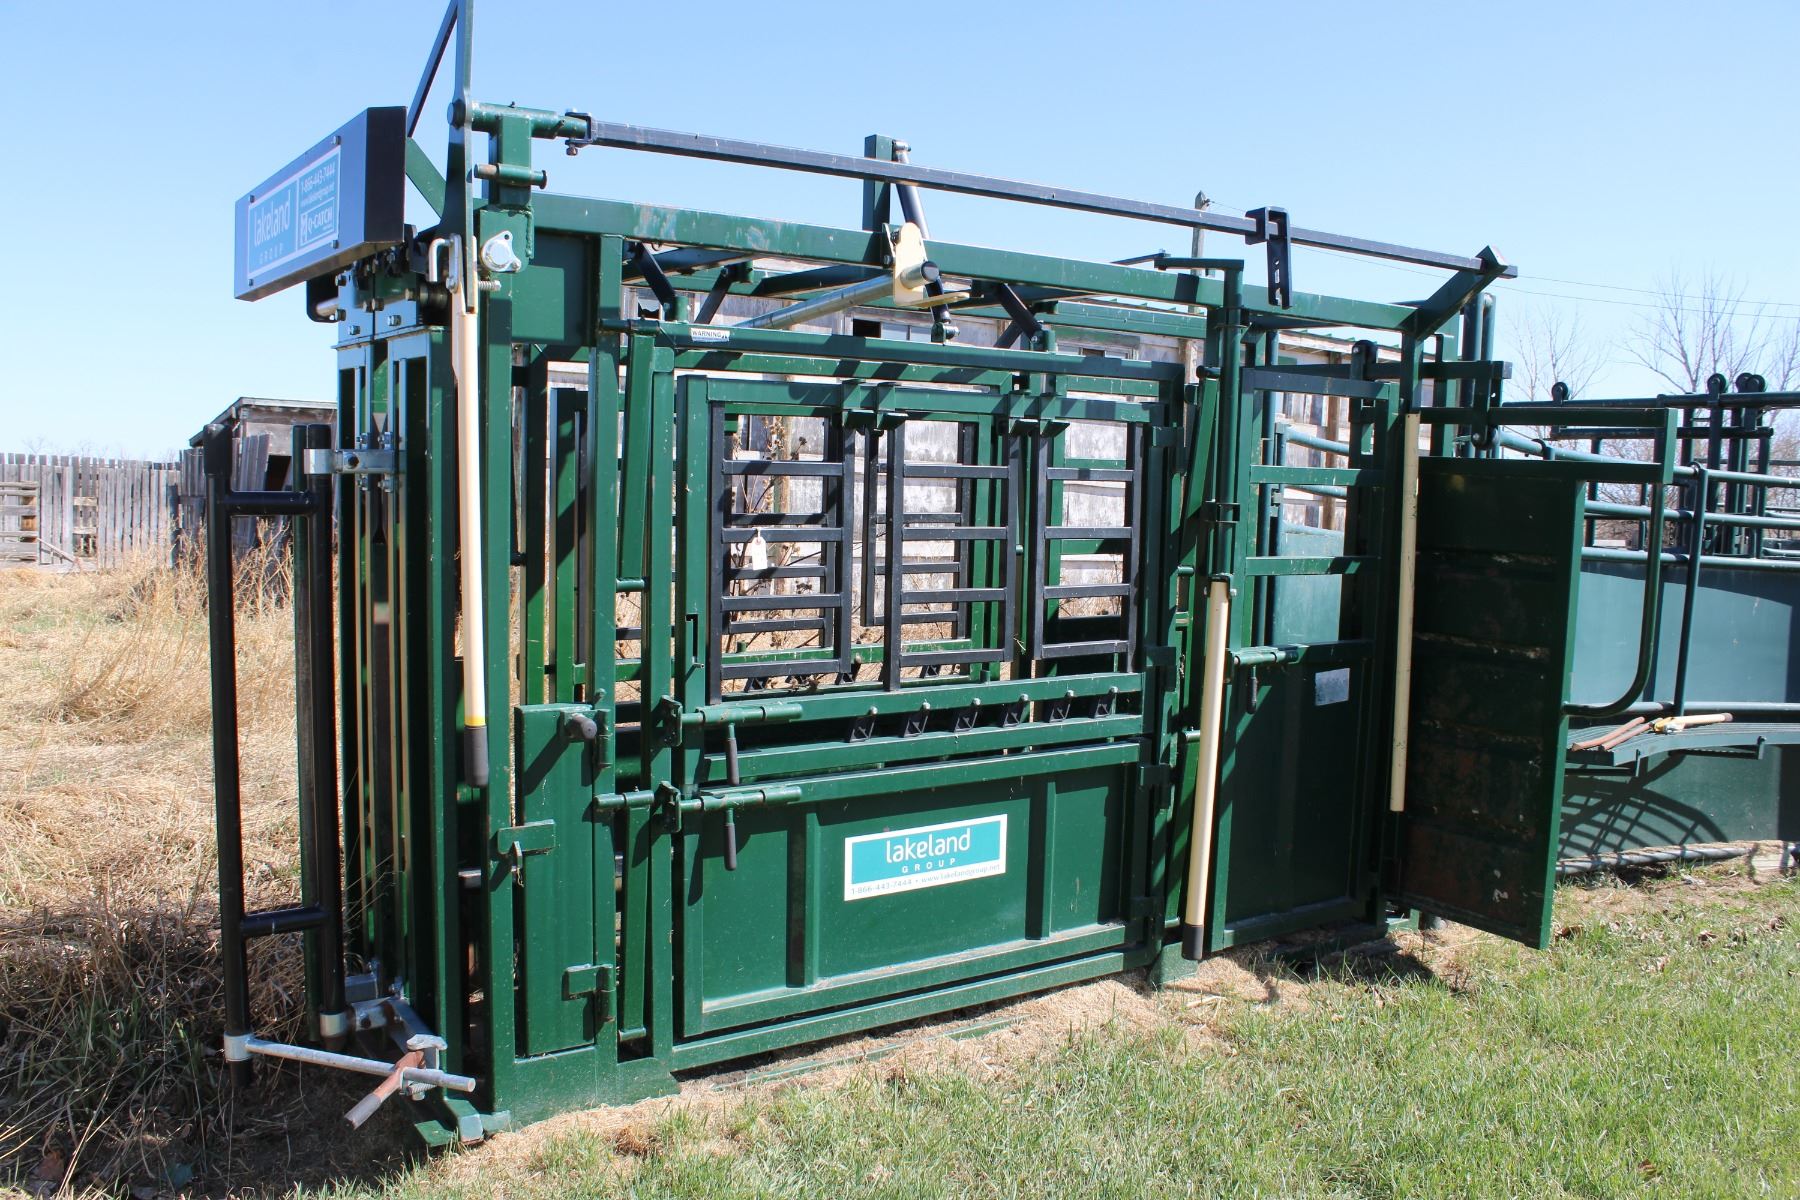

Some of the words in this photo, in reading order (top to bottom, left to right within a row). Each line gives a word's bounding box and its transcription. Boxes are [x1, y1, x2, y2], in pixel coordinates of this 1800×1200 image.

[254, 189, 291, 246] lakeland
[692, 330, 721, 338] WARNING
[886, 828, 971, 863] lakeland
[901, 857, 956, 873] GROUP
[851, 878, 912, 895] 1-866-443-7444
